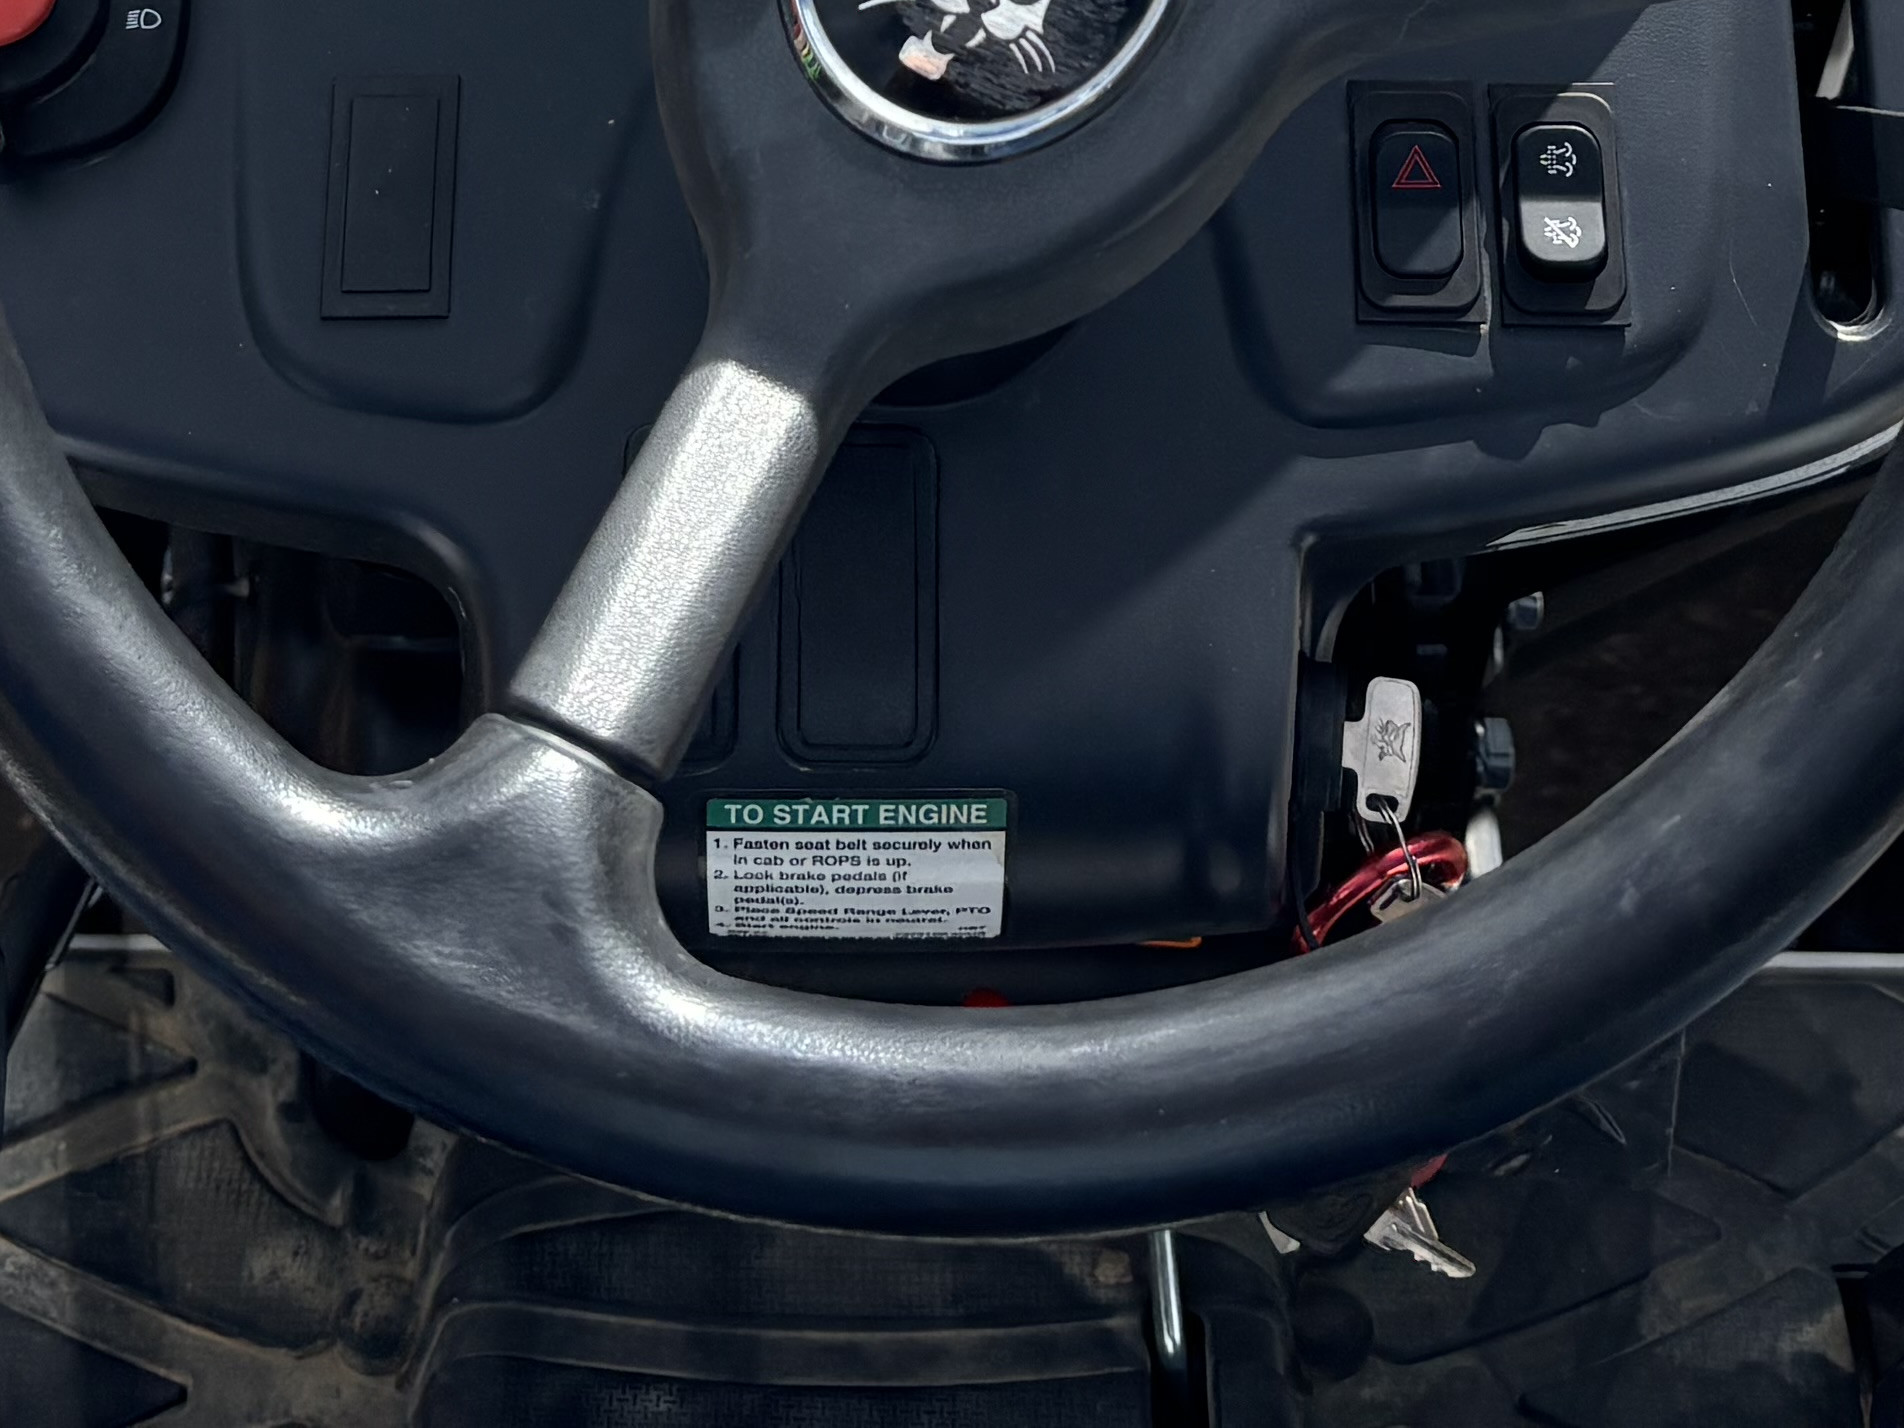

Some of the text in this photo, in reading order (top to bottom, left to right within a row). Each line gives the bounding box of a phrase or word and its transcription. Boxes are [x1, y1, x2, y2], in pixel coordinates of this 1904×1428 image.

[724, 804, 988, 825] TO START ENGINE
[713, 838, 992, 853] 1. Fasten seat belt securely when
[753, 855, 784, 866] cab
[789, 857, 807, 867] or
[812, 855, 862, 866] ROPS
[866, 855, 880, 867] is
[886, 857, 911, 868] up.
[734, 870, 773, 881] Lock
[779, 871, 826, 881] brake
[831, 871, 887, 883] pedals
[835, 885, 902, 895] depress
